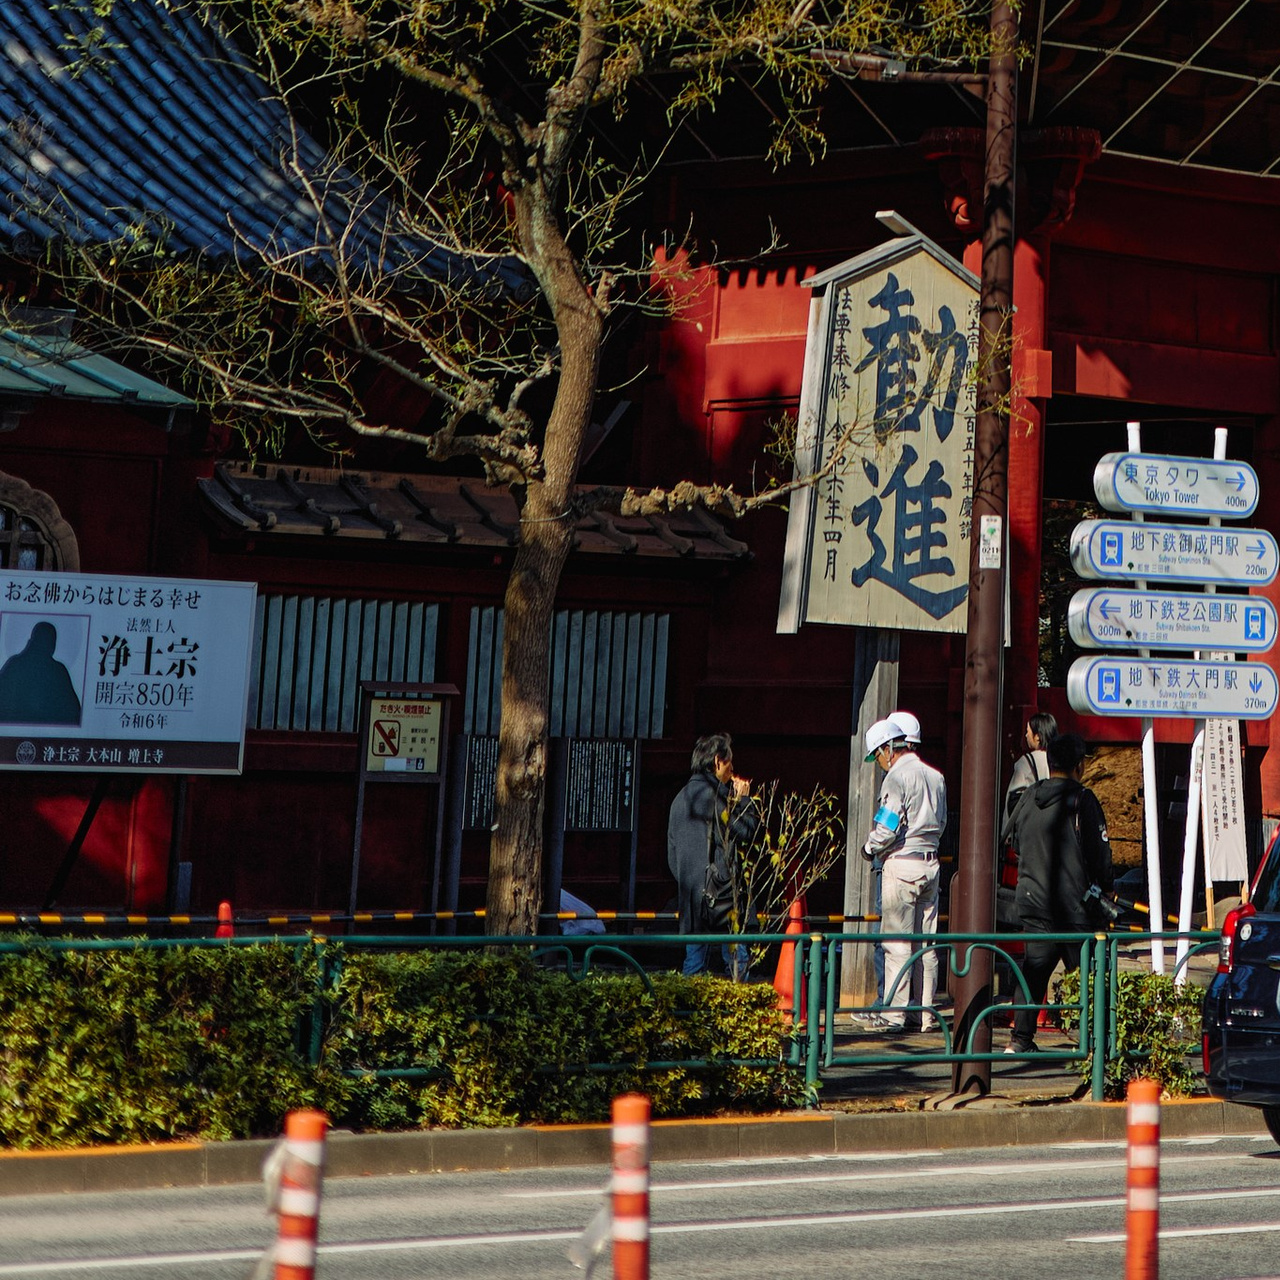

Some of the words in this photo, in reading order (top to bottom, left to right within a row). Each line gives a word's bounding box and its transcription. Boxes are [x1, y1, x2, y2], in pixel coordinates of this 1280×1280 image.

[852, 272, 969, 621] 勧進
[1125, 462, 1219, 487] 東京タワー
[1144, 487, 1170, 504] Tokyo
[1174, 489, 1200, 504] Tower
[1225, 496, 1247, 507] 400m
[1131, 531, 1239, 556] 地下鉄御成門駅
[1246, 564, 1268, 575] 220m
[5, 581, 202, 610] お念佛からはじまる幸せ
[1129, 599, 1238, 623] 地下鉄芝公園駅
[126, 617, 176, 634] 法然上人
[1098, 625, 1121, 636] 300m
[98, 634, 200, 679] 浄土宗
[1129, 667, 1238, 690] 地下鉄大門駅
[95, 681, 194, 708] 開宗850年
[1244, 698, 1267, 709] 370m
[119, 712, 168, 730] 令和6年
[42, 746, 80, 763] 浄土宗
[86, 748, 122, 763] 大本山
[128, 749, 164, 765] 増上寺
